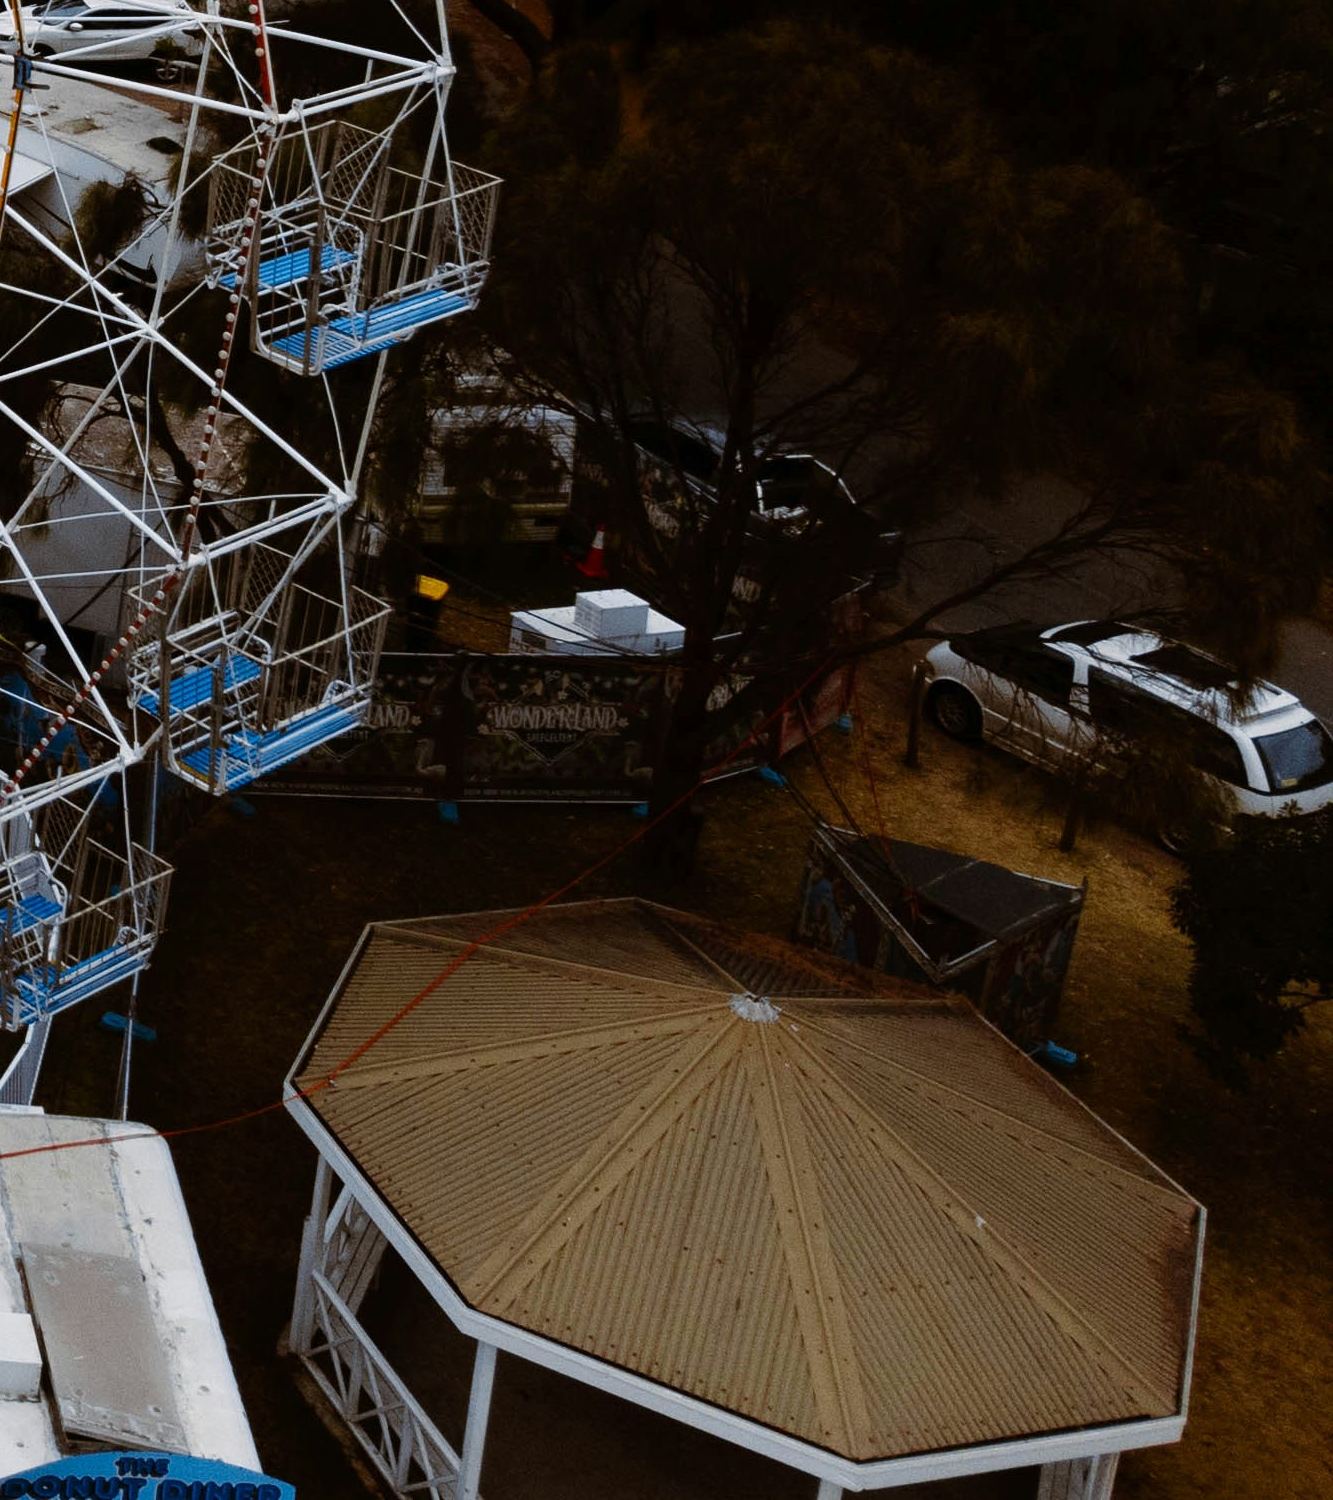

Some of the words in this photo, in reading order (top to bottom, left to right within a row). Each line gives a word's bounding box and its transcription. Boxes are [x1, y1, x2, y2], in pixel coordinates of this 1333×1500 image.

[494, 702, 618, 731] WONDERLAND
[116, 1457, 170, 1477] THE
[0, 1476, 147, 1500] DONUT
[156, 1479, 282, 1500] DINER
